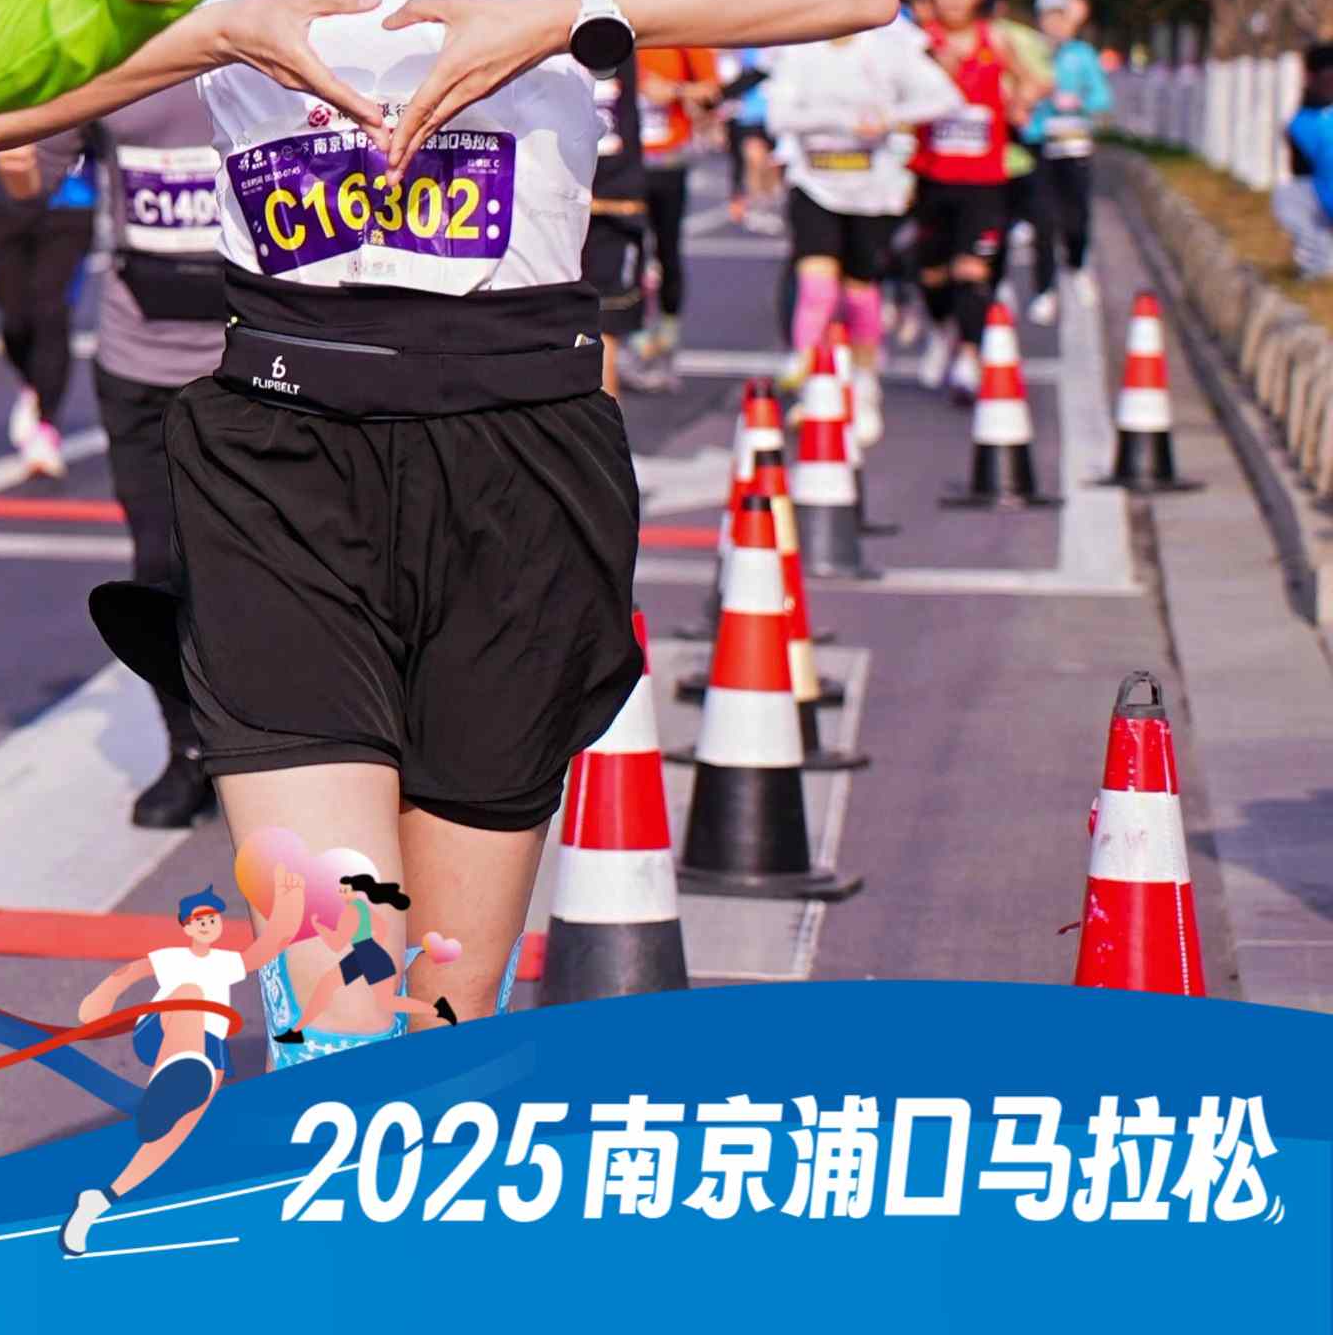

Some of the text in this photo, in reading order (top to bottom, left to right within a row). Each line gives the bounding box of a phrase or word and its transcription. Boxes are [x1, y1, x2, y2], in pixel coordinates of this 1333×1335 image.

[134, 188, 221, 225] C140
[263, 169, 481, 252] C16302
[253, 376, 300, 395] FLIPBELT
